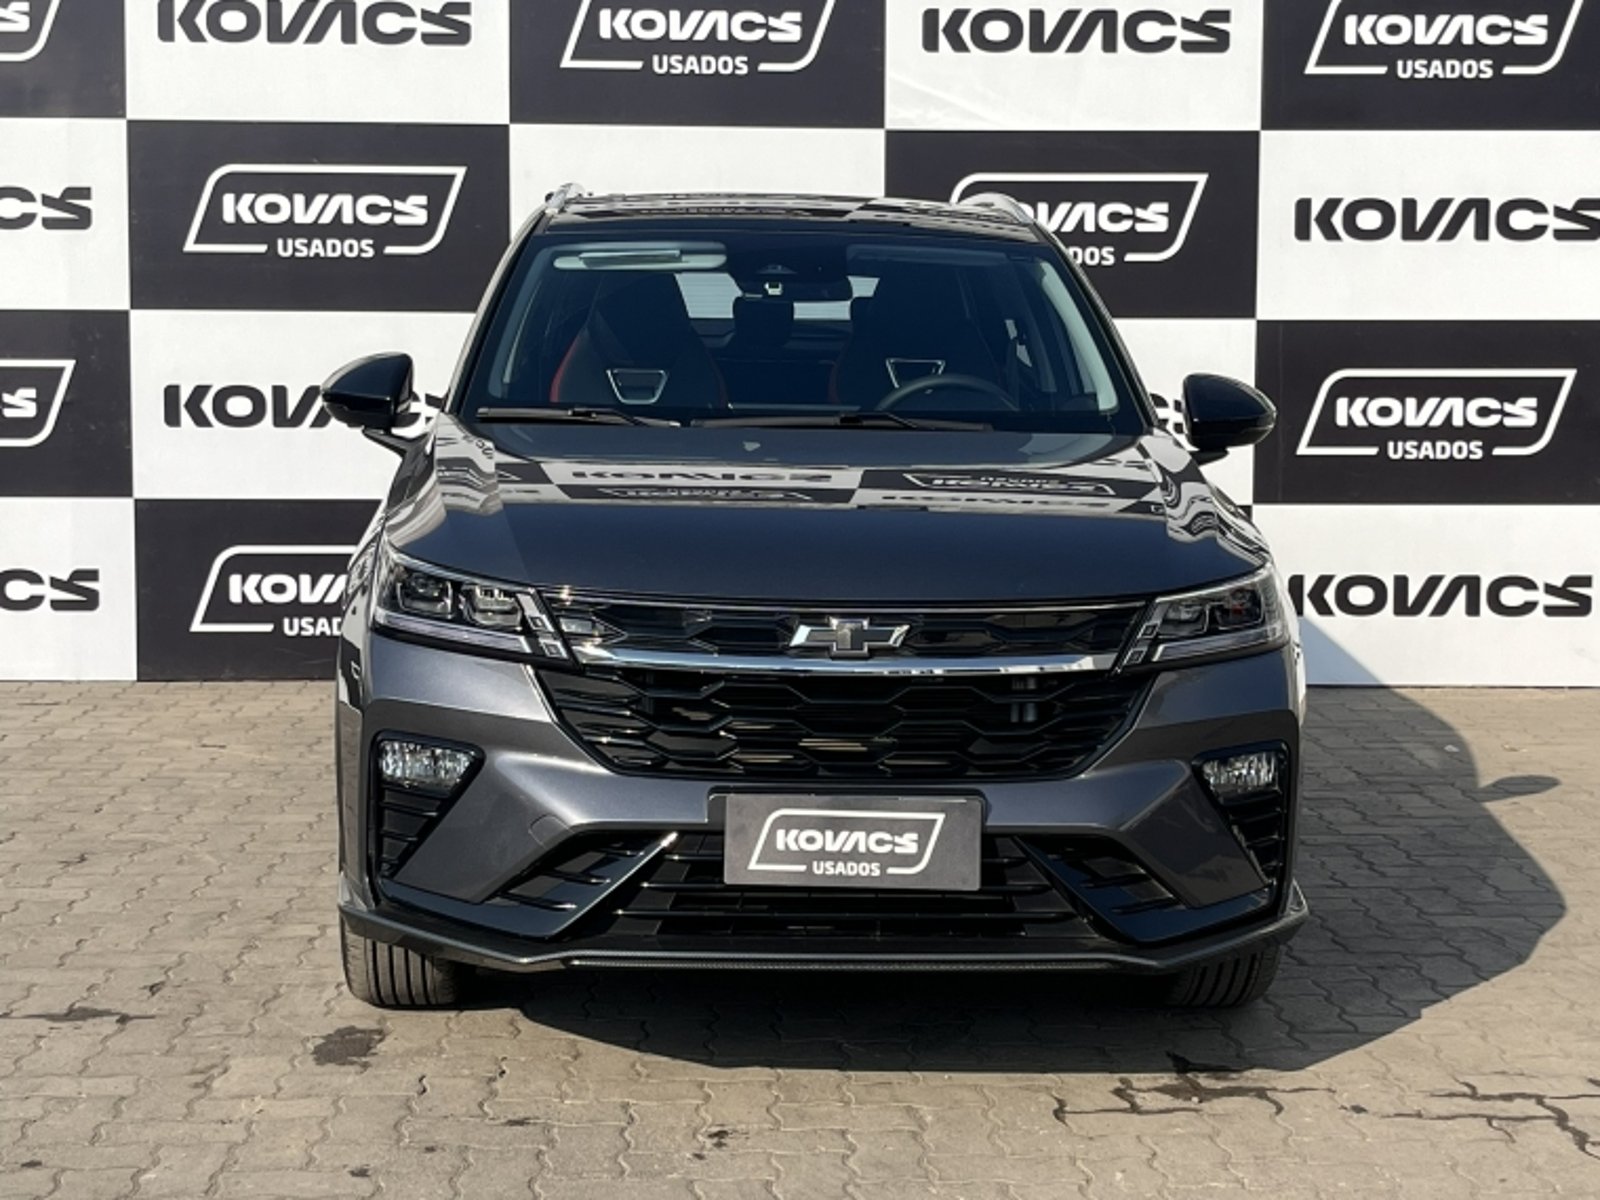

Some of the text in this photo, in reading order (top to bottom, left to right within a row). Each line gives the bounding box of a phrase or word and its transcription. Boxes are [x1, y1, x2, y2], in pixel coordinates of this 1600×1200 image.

[158, 0, 471, 45] KOVACS
[600, 9, 802, 42] KOVACS
[922, 8, 1231, 53] KOVACS
[1345, 15, 1548, 45] KOVACS
[652, 55, 749, 75] USADOS
[1397, 60, 1494, 79] USADOS
[222, 193, 428, 226] KOVACS
[1022, 203, 1169, 232] VACS
[1295, 197, 1600, 241] KOVACS
[277, 238, 375, 258] USADOS
[1070, 246, 1115, 266] DOS
[1335, 397, 1538, 427] KOVACS
[1387, 441, 1483, 460] USADOS
[1287, 574, 1593, 617] KOVACS
[283, 616, 342, 636] USAD
[777, 829, 919, 854] KOVACS
[813, 861, 881, 876] USADOS
